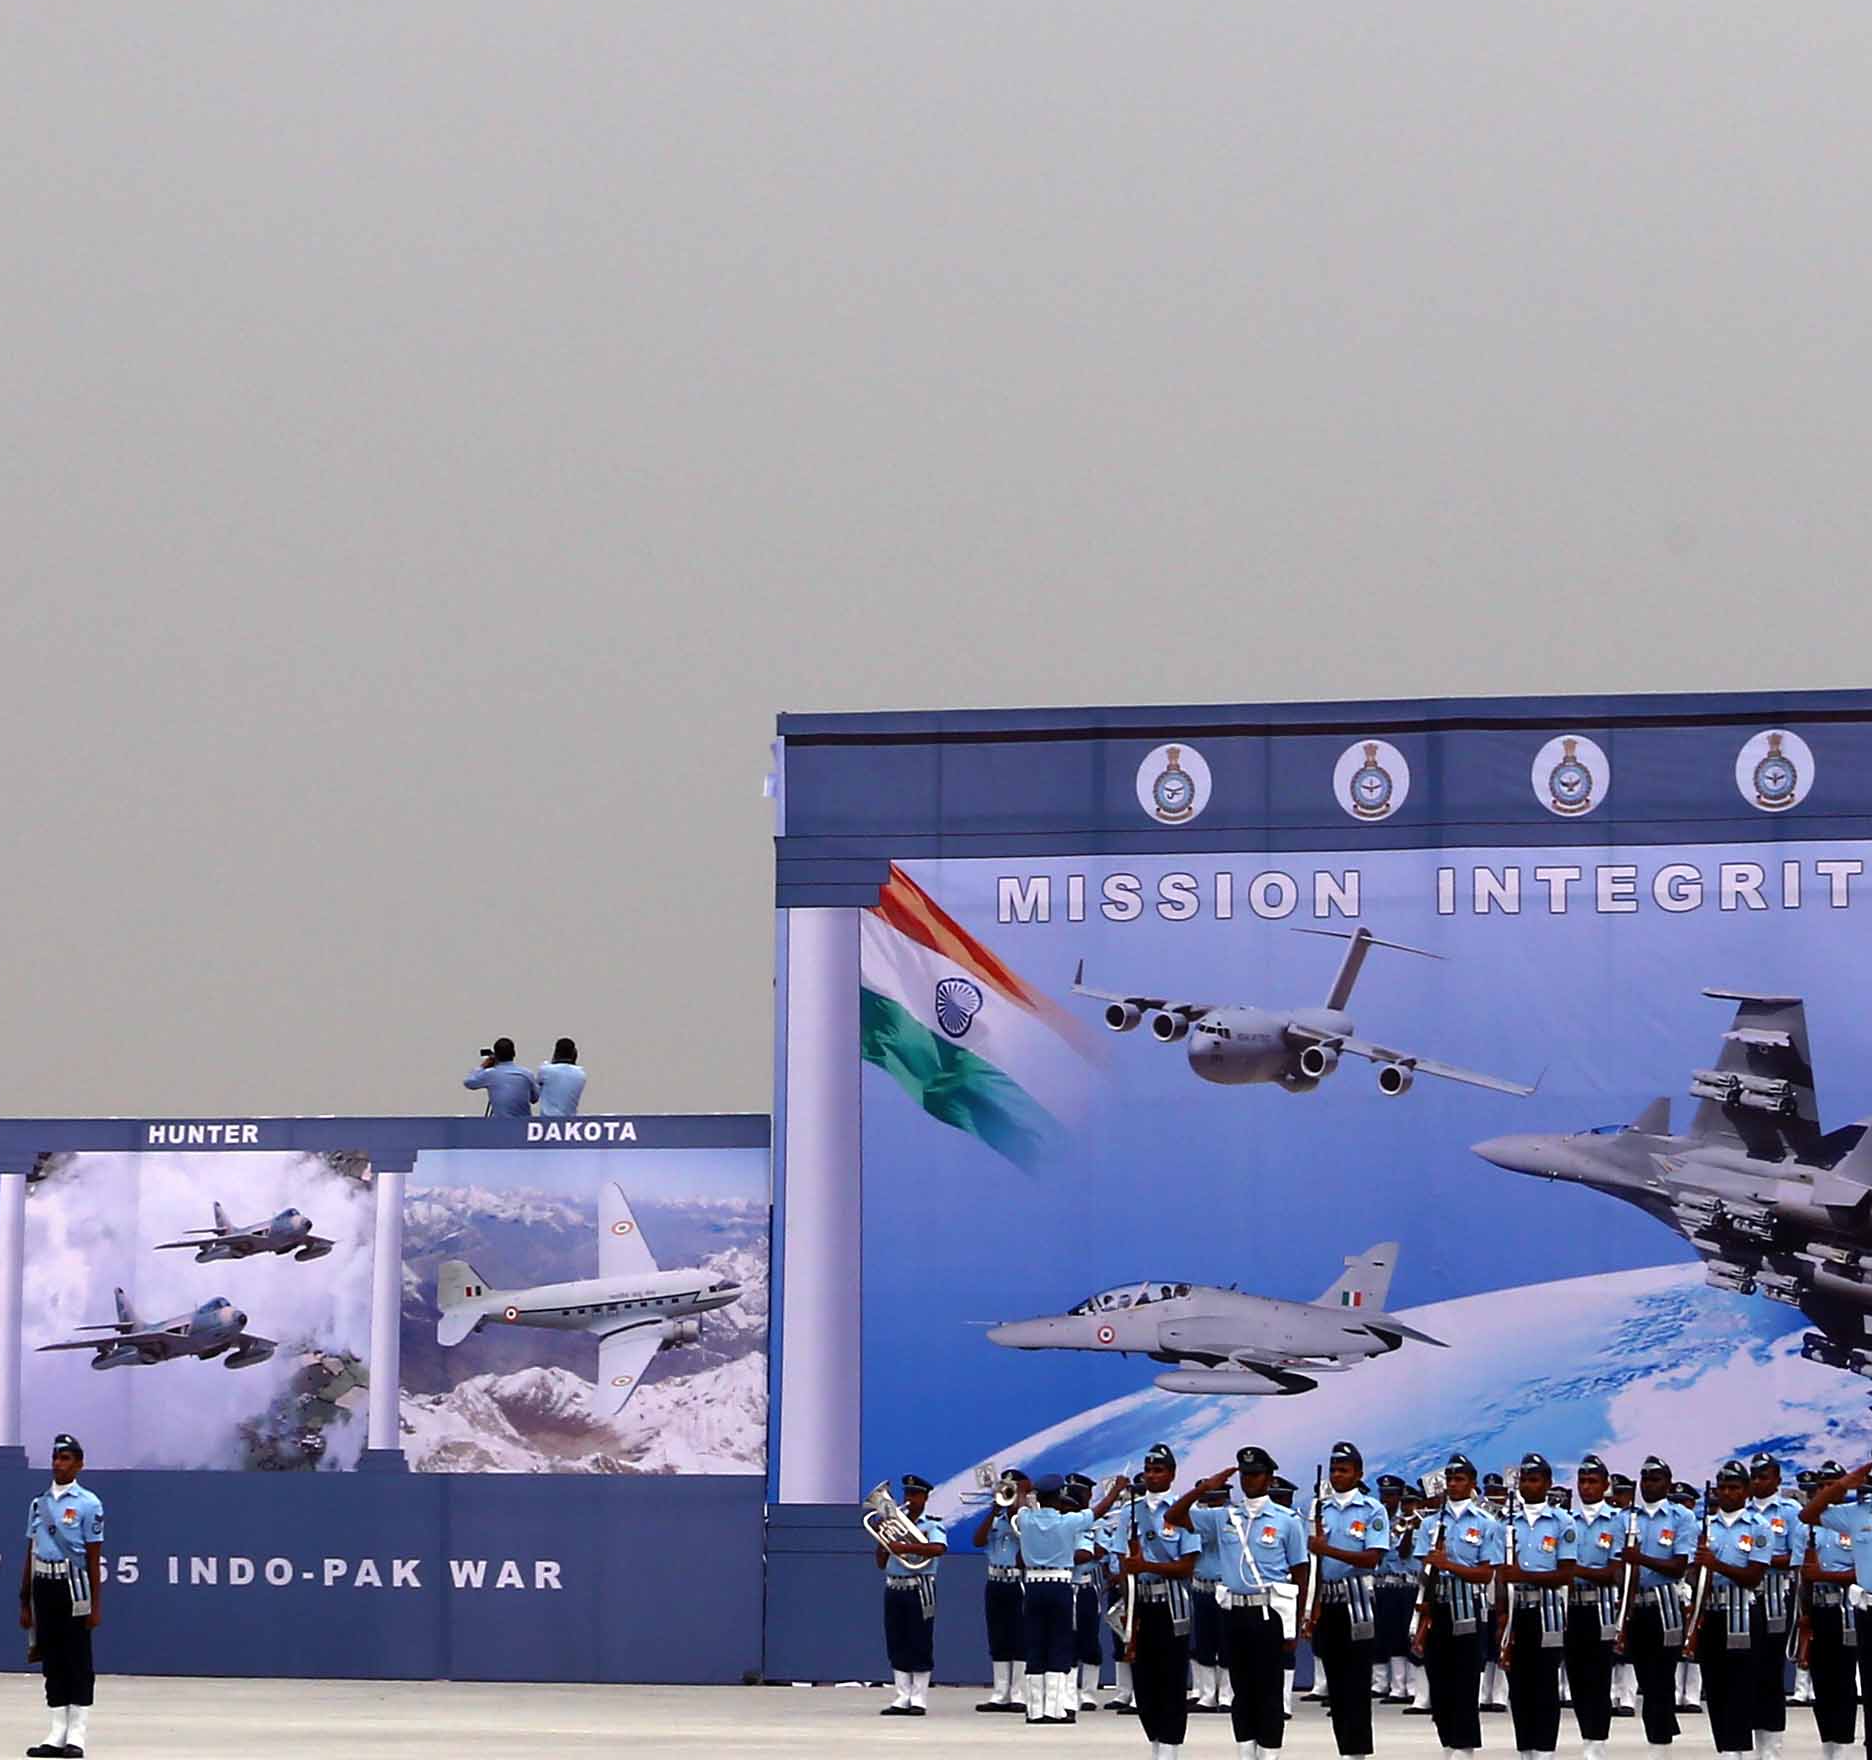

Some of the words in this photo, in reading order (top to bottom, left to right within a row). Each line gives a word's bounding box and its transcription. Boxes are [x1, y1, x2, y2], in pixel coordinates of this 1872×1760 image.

[996, 869, 1362, 924] MISSION
[147, 1124, 260, 1144] HUNTER
[527, 1121, 638, 1141] DAKOTA
[167, 1556, 423, 1588] INDO-PAK
[448, 1559, 563, 1589] WAR
